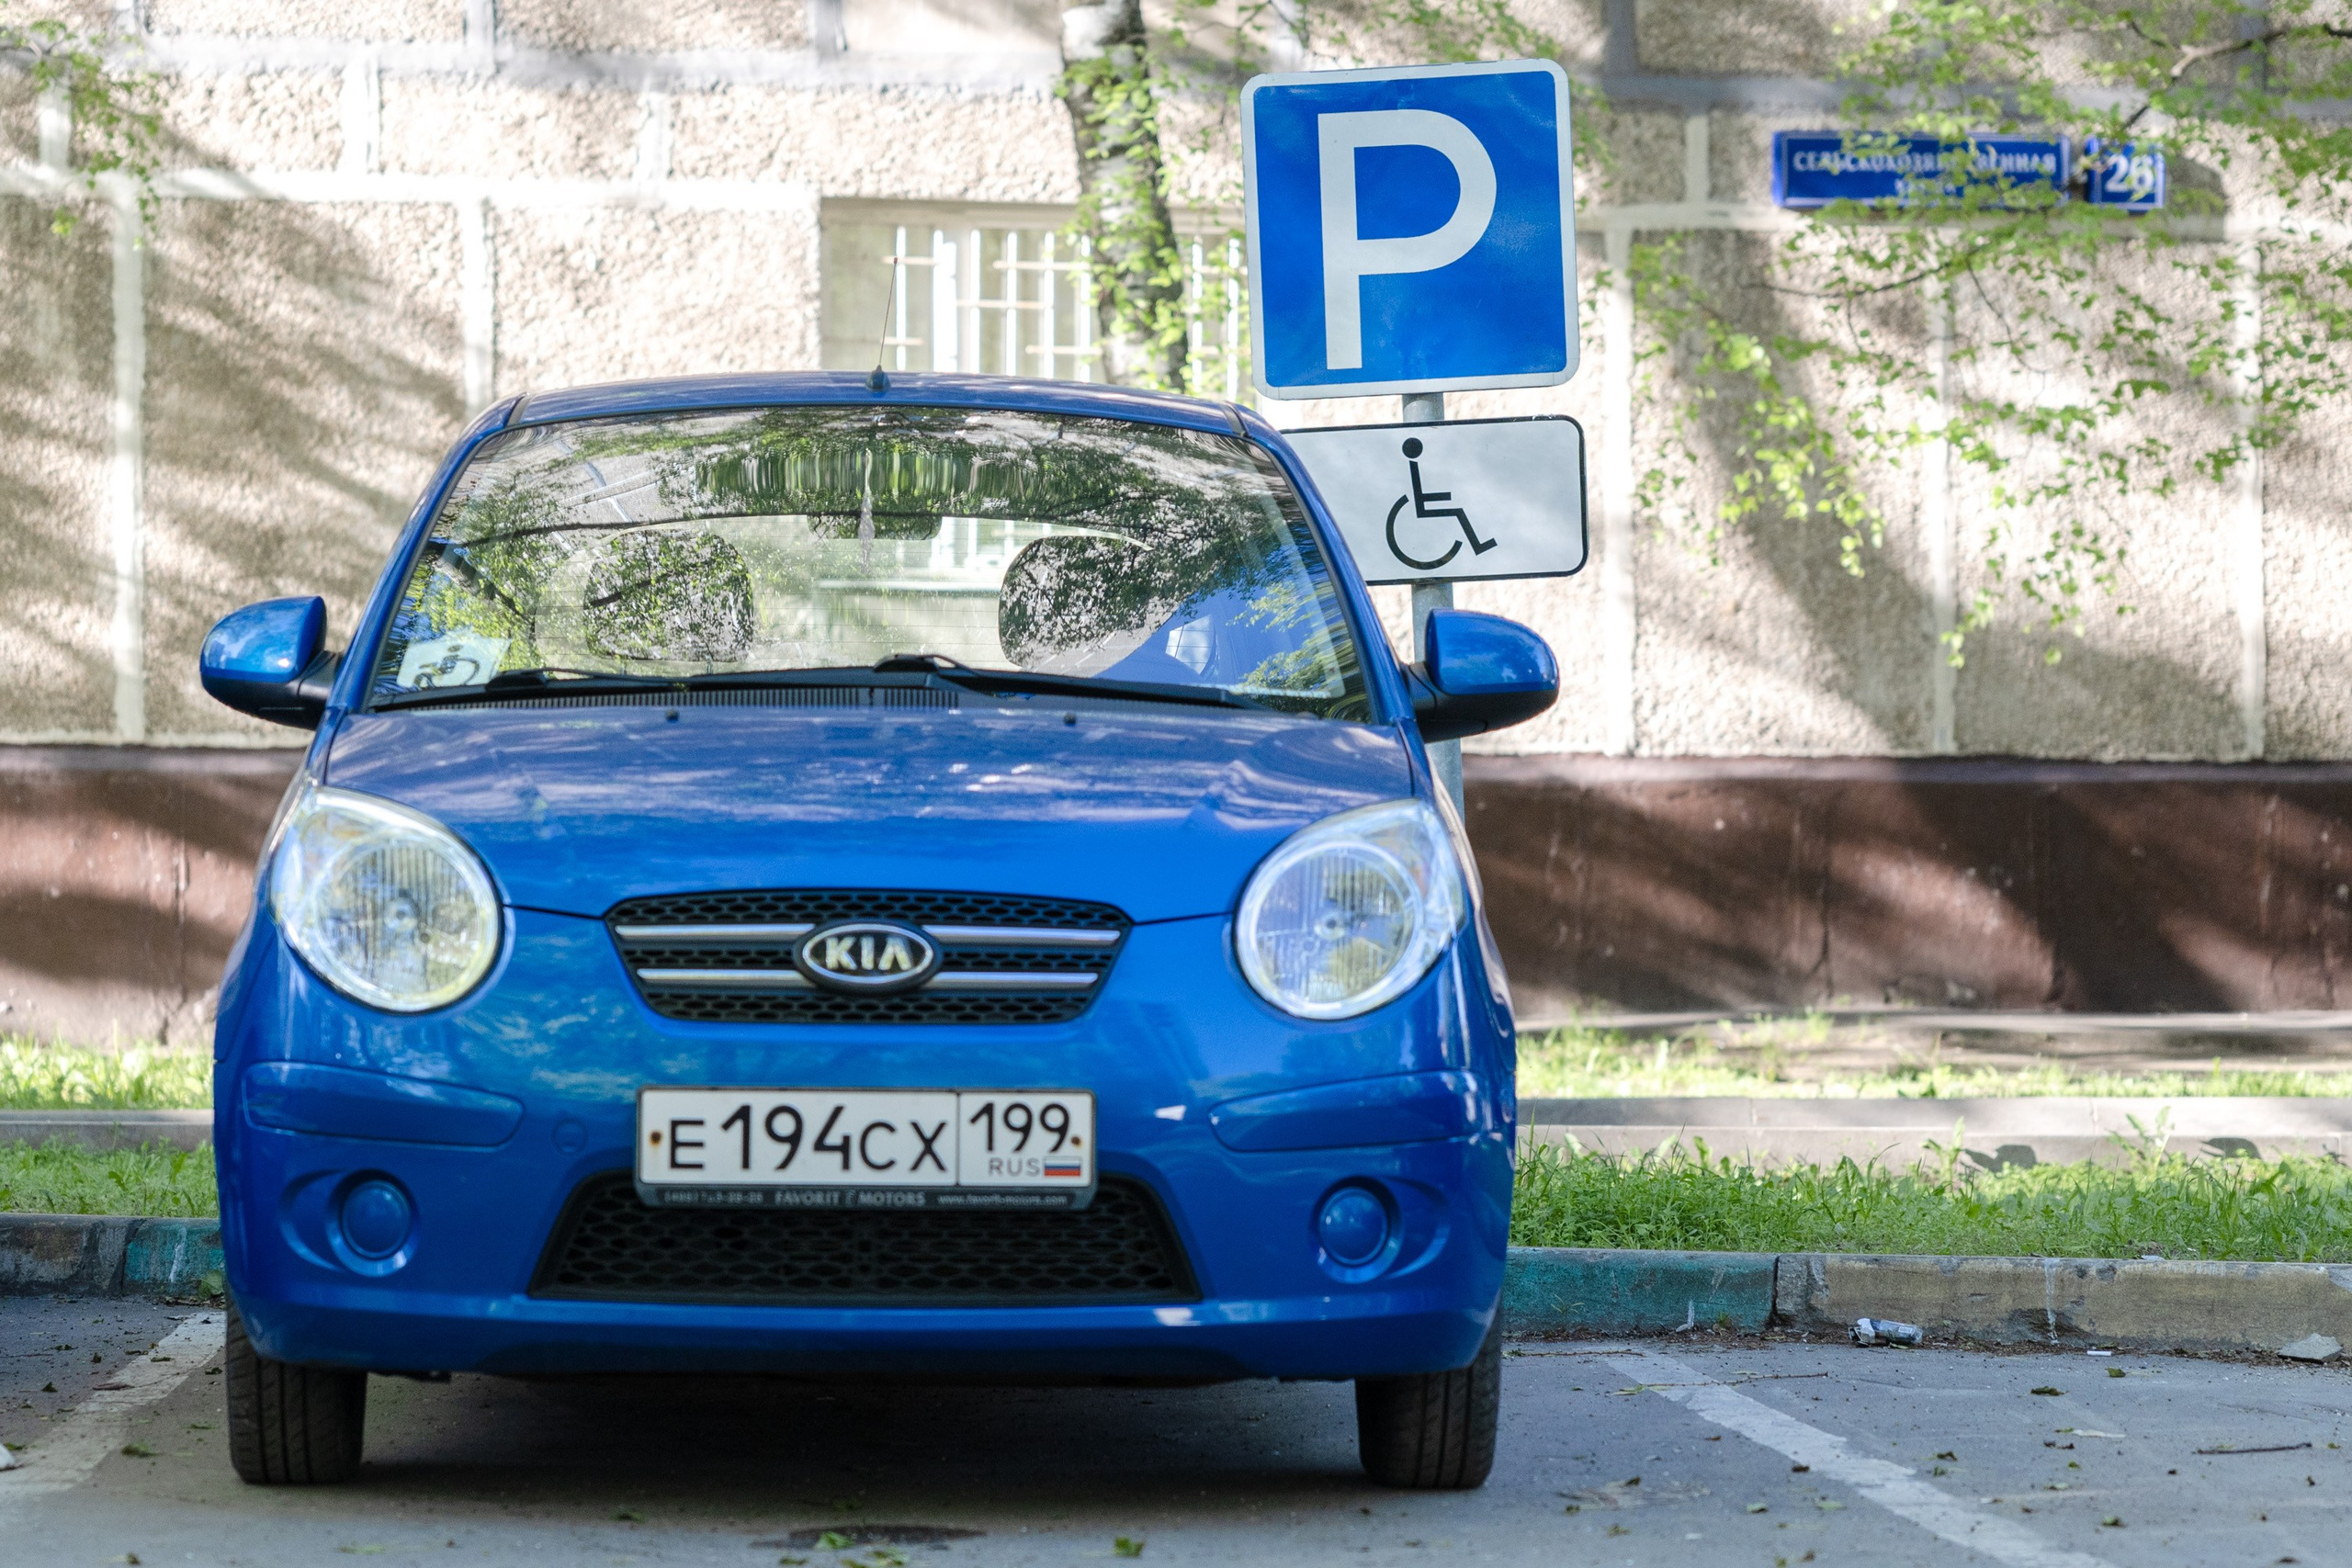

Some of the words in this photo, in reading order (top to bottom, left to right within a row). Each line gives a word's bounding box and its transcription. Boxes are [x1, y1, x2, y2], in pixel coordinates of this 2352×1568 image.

[1317, 109, 1498, 370] P
[825, 936, 912, 971] KIA
[969, 1102, 1070, 1154] 199
[988, 1156, 1041, 1178] RUS
[775, 1190, 840, 1207] FAVORIT
[858, 1190, 926, 1207] MOTORS
